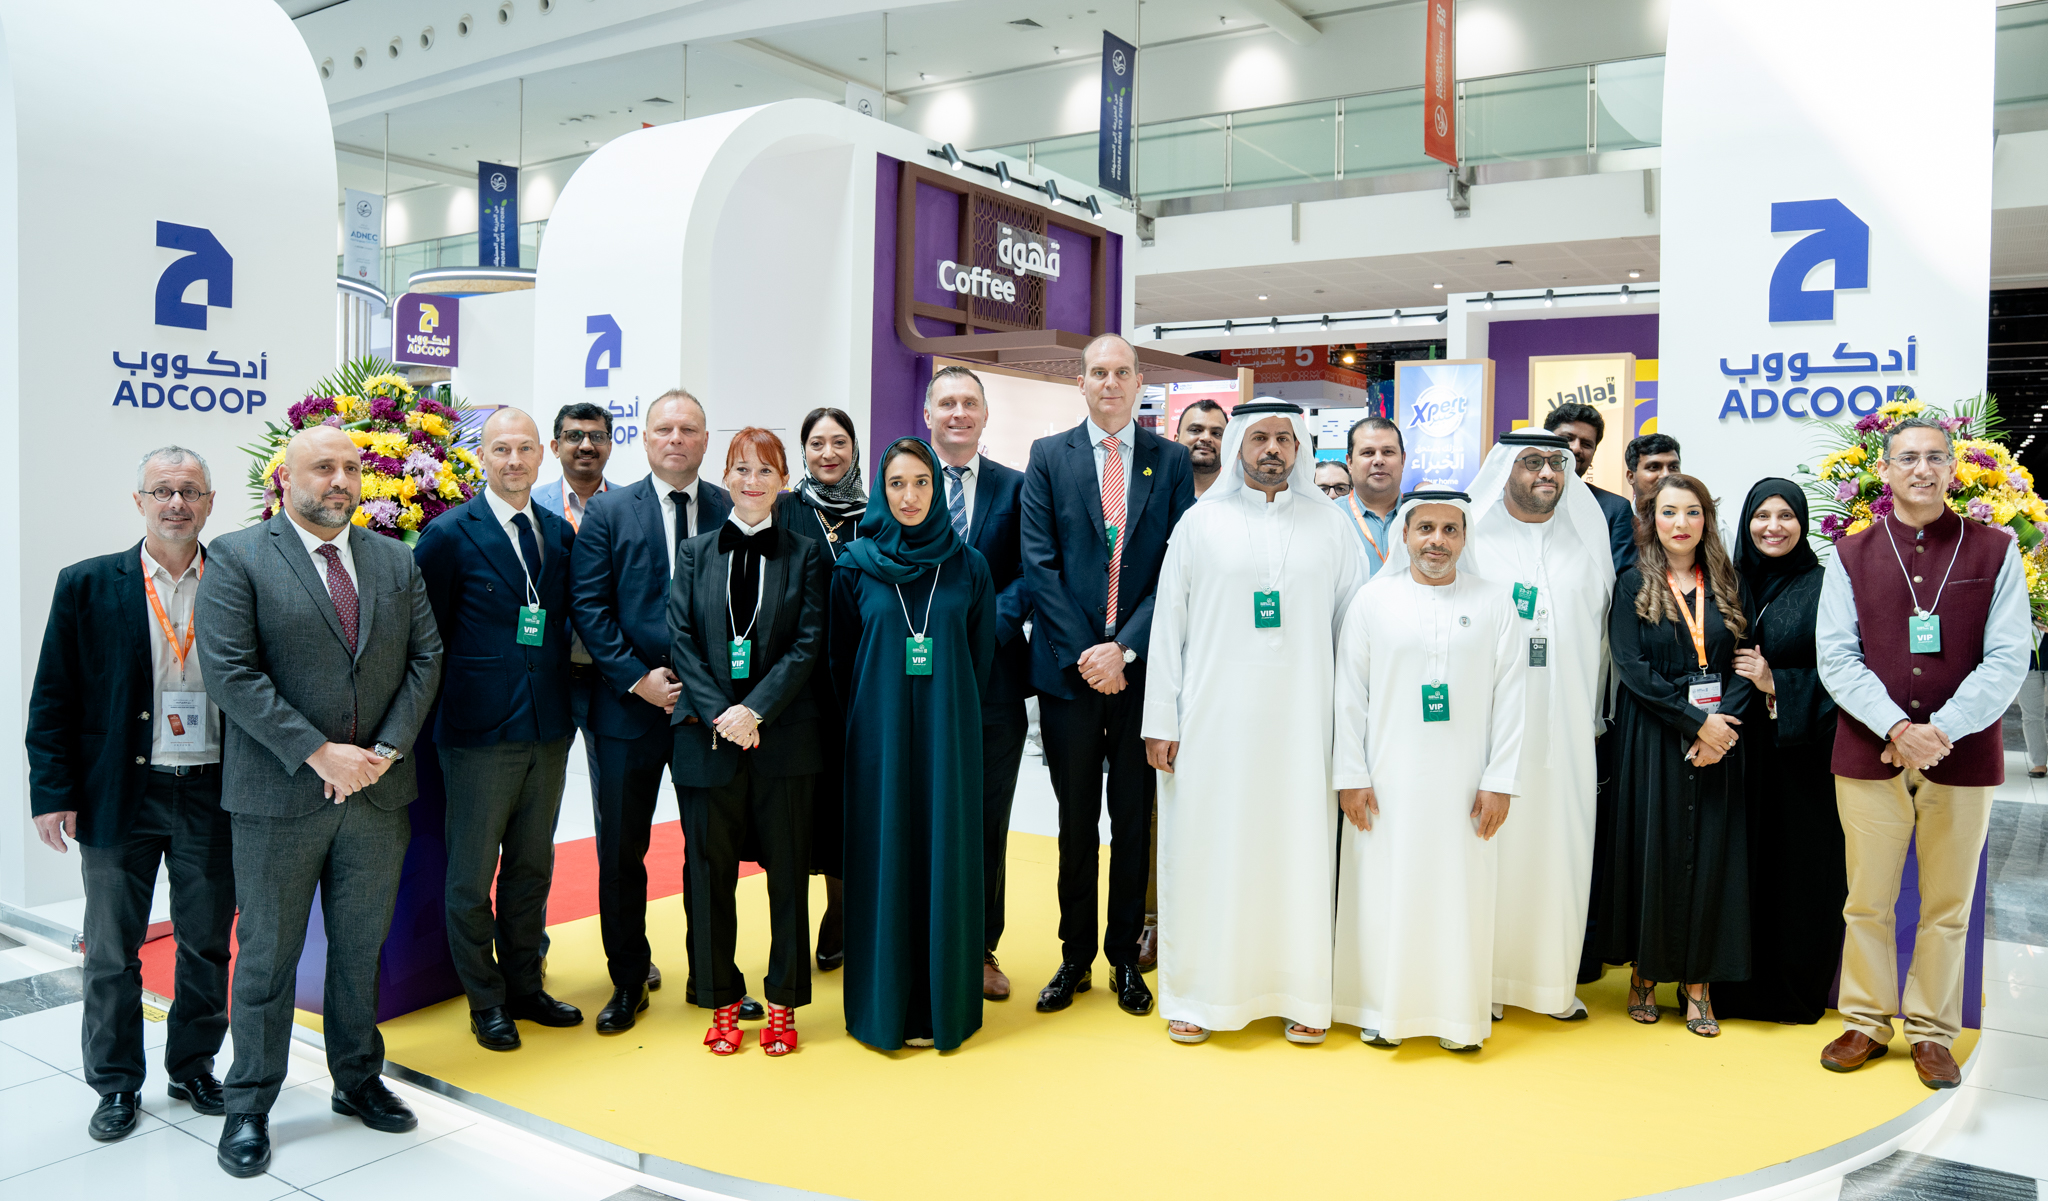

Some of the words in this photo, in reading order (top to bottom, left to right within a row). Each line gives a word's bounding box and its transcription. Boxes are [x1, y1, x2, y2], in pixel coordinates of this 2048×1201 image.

[350, 230, 378, 242] ADNEC
[998, 227, 1060, 278] قهوة
[939, 260, 1016, 303] Coffee
[112, 350, 267, 380] أدكووب
[407, 343, 450, 357] ADCOOP
[1295, 345, 1314, 367] 5
[1720, 335, 1917, 383] أدكووب
[112, 380, 267, 414] ADCOOP
[1410, 397, 1466, 427] Xpert
[1718, 385, 1916, 419] ADCOOP
[1411, 453, 1464, 474] الخبراء
[524, 626, 538, 634] VIP
